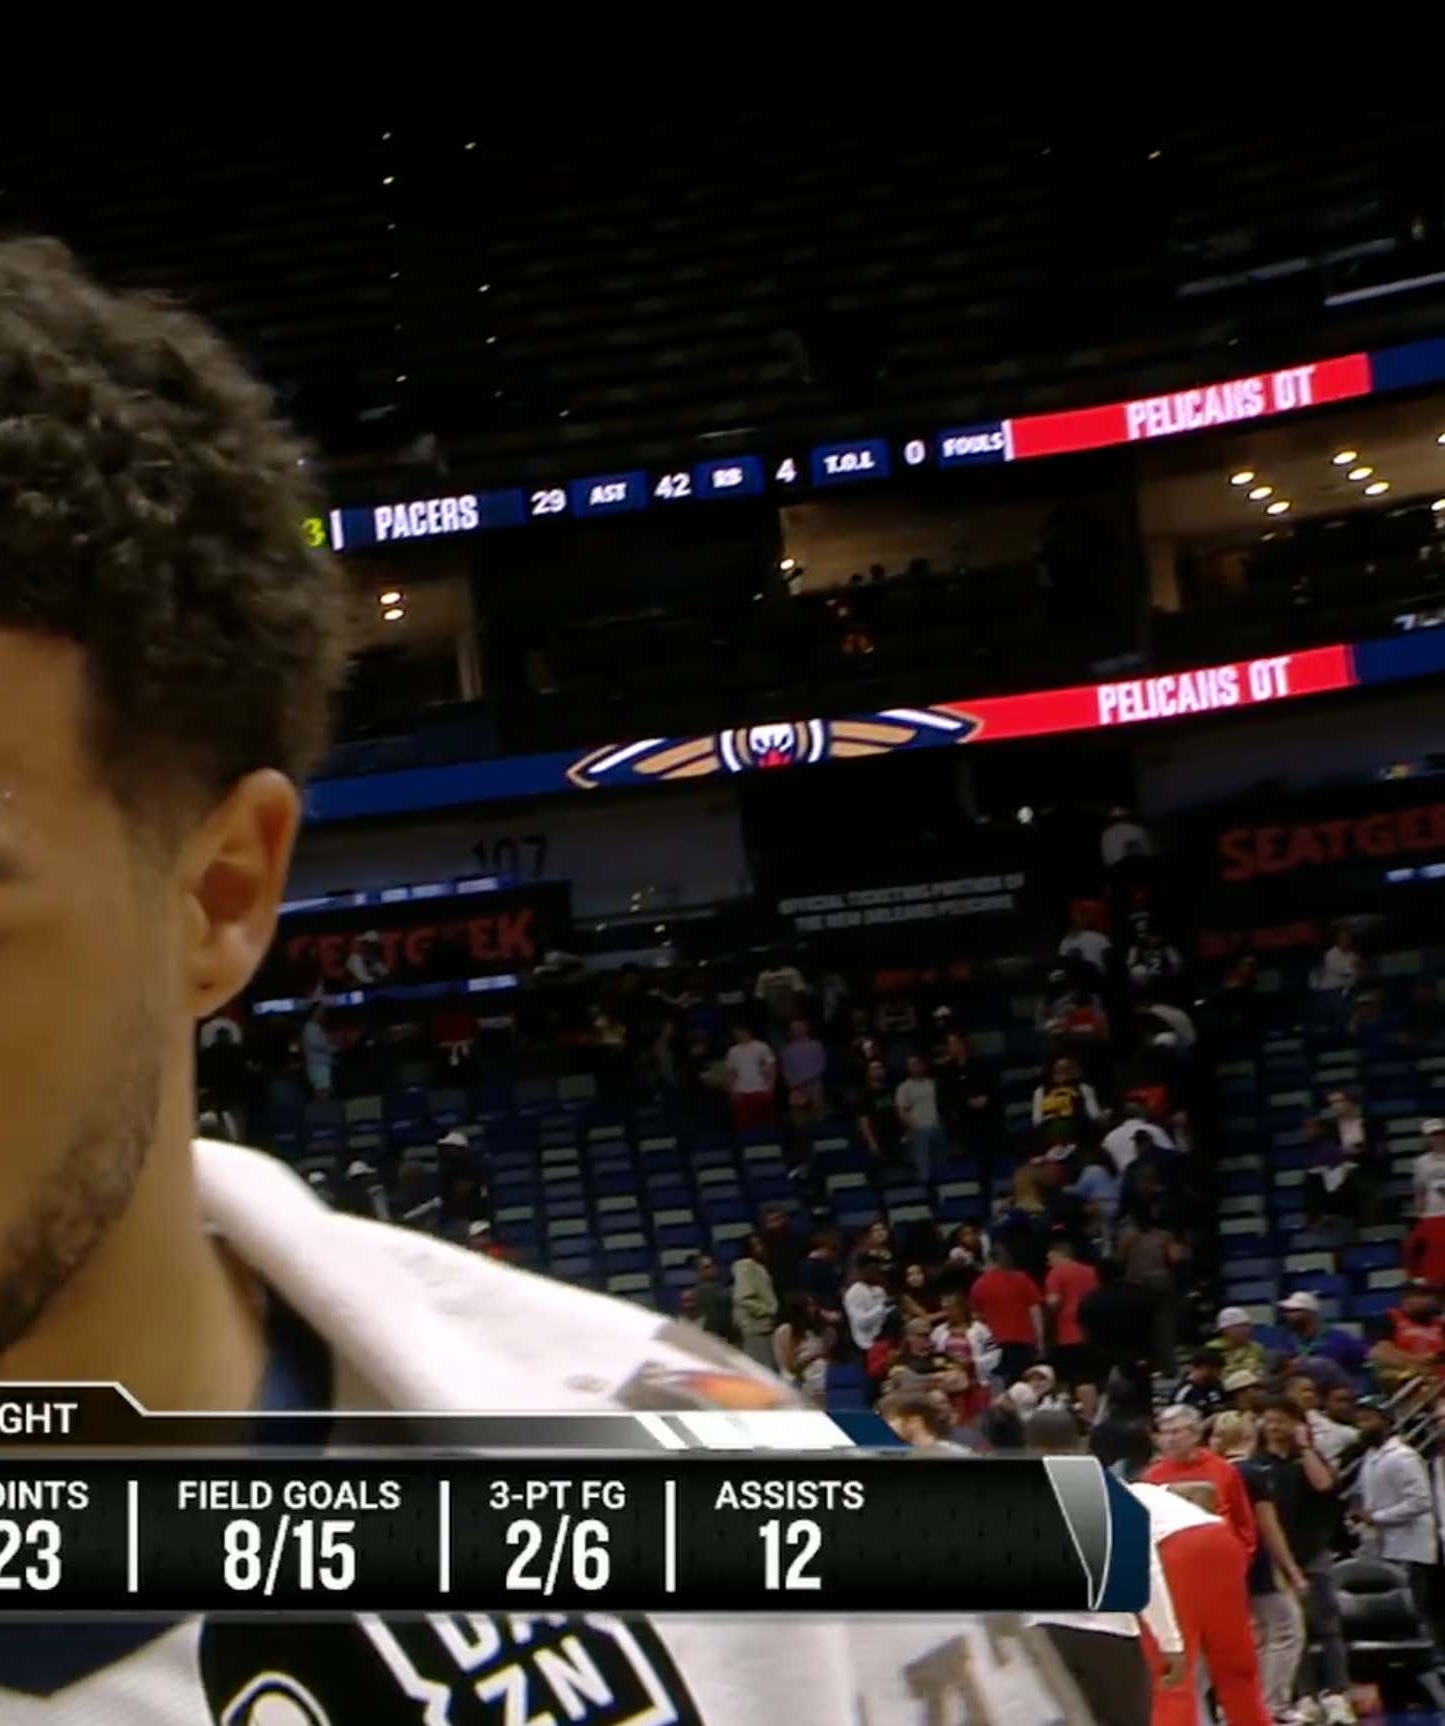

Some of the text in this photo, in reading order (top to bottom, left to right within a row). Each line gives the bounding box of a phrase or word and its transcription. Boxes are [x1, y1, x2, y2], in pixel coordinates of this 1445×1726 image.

[1125, 365, 1316, 440] PELICANS OT
[530, 488, 567, 516] 29
[589, 482, 627, 505] AST
[653, 472, 692, 500] 42
[775, 457, 797, 484] 4
[904, 439, 926, 466] 0
[942, 432, 1004, 458] FOULS
[374, 494, 479, 541] PACERS
[1097, 656, 1291, 726] PELICANS OT
[471, 834, 547, 881] 107
[475, 1635, 615, 1726] ZN
